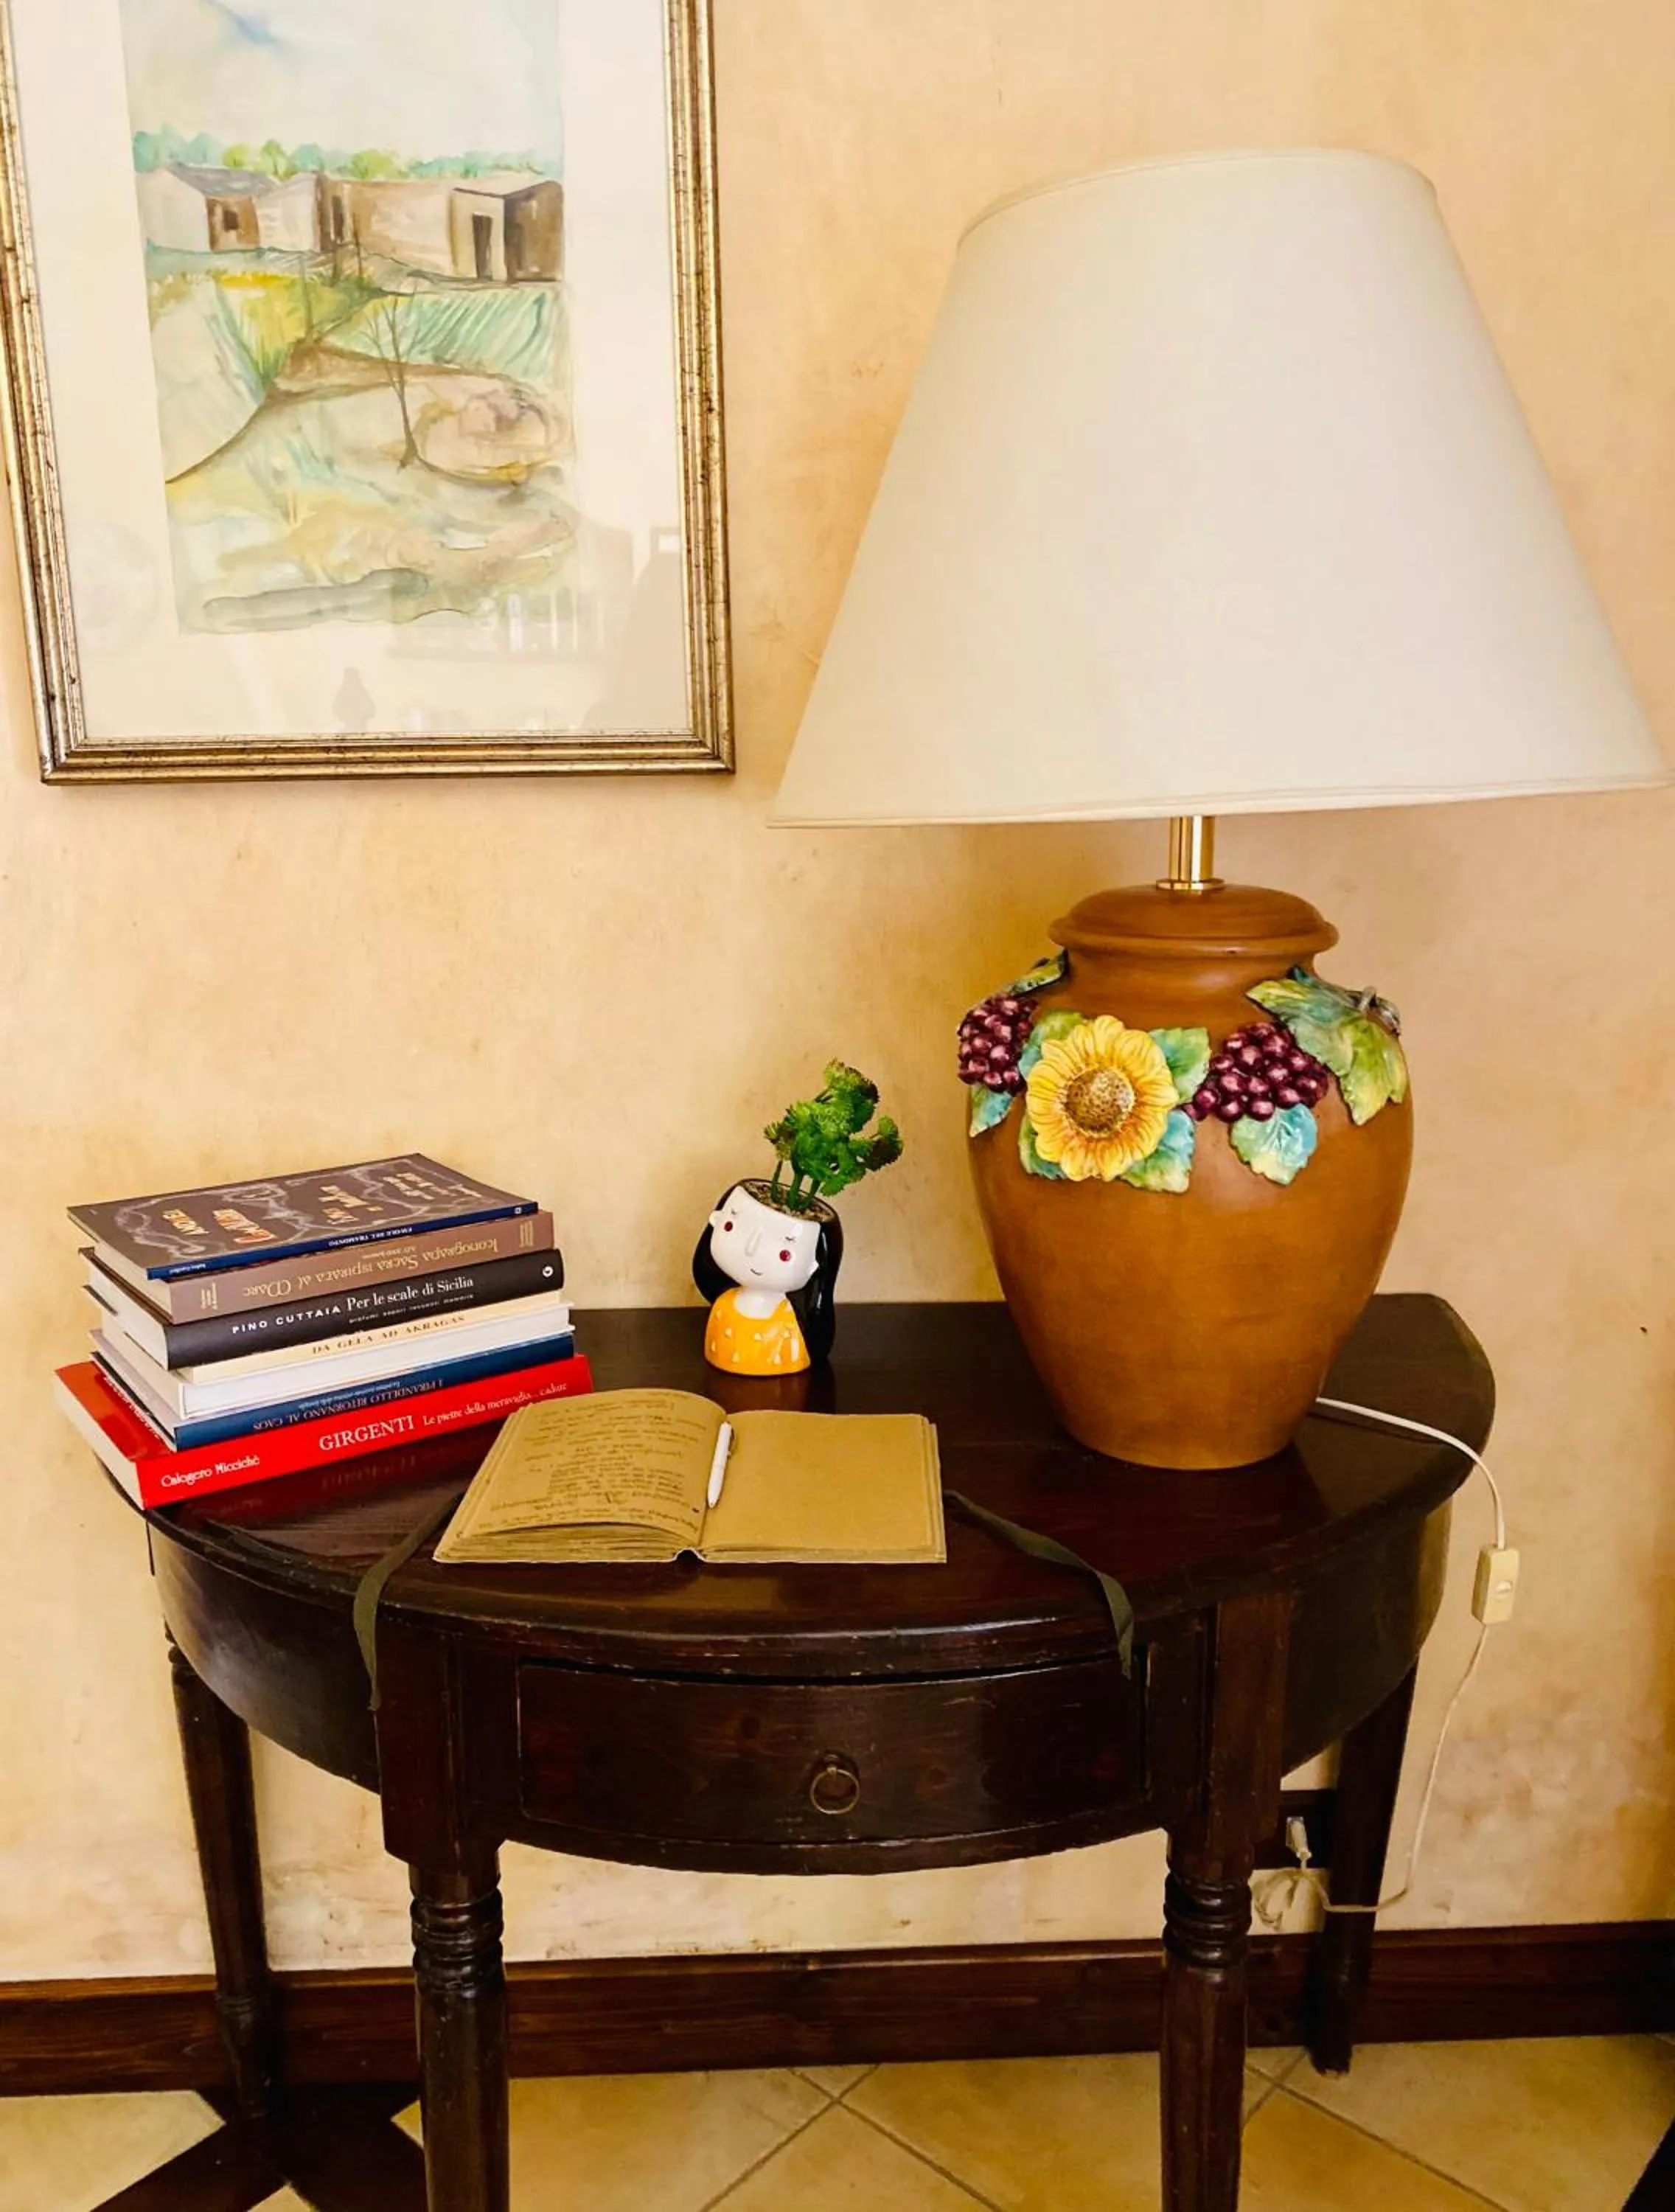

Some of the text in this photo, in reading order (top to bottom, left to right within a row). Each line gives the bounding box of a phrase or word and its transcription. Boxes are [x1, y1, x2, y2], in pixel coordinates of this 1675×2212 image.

[232, 1276, 474, 1334] PINO CUTTAIA Per le scale di Sicilia
[338, 1335, 374, 1349] GELA
[161, 1468, 212, 1487] Calogero
[319, 1415, 414, 1450] GIRGENTI
[422, 1415, 436, 1426] Le
[464, 1400, 487, 1416] della
